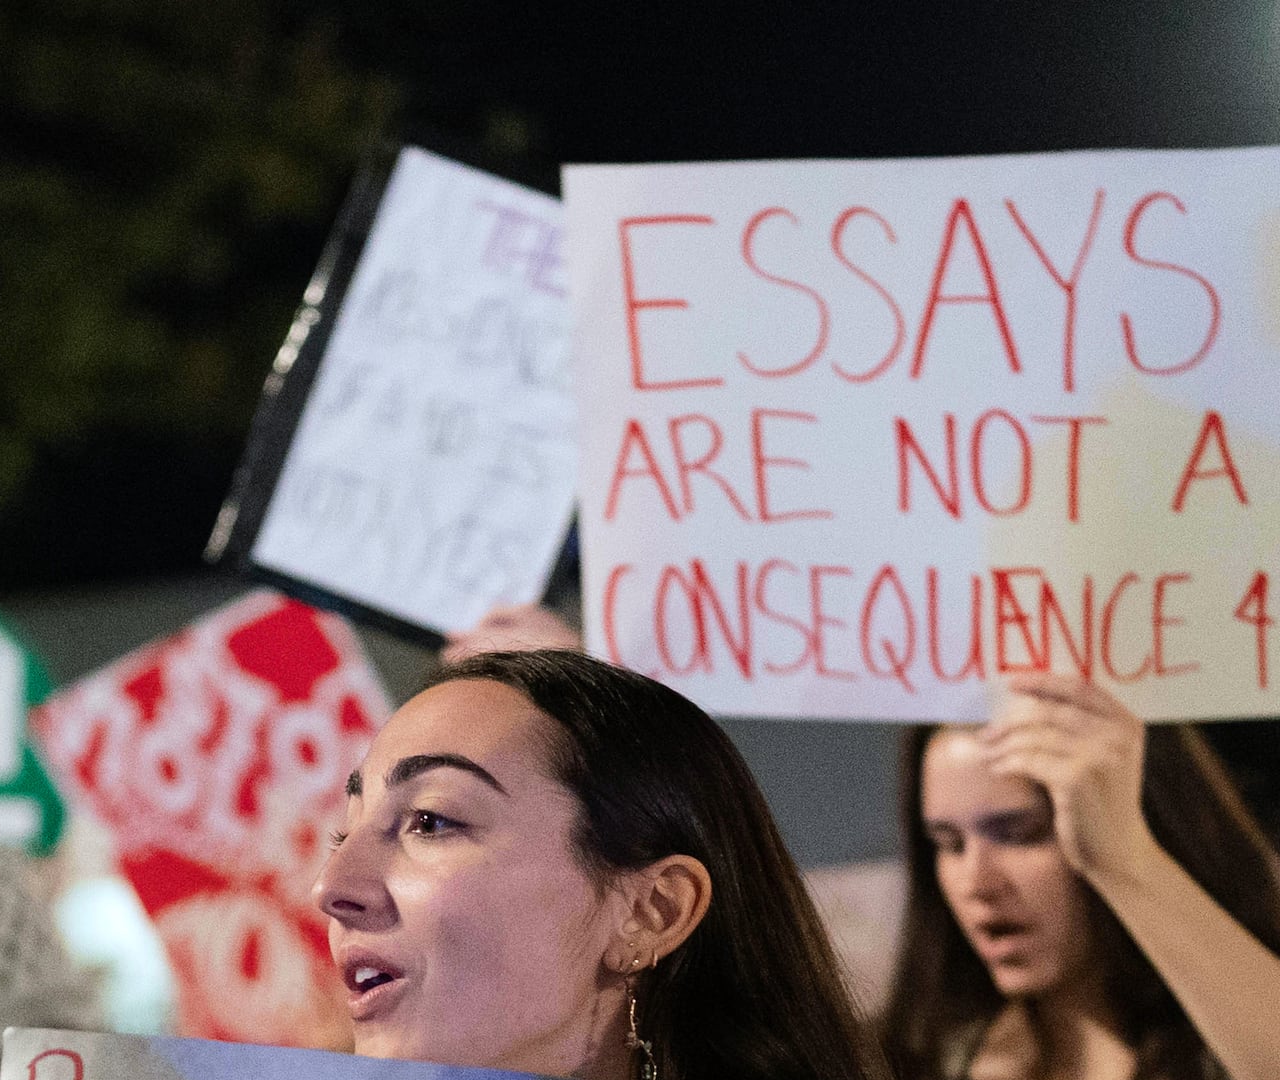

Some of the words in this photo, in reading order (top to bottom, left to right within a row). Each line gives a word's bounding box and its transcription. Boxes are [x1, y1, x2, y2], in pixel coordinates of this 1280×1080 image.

[618, 187, 1222, 393] ESSAYS
[603, 405, 834, 523] ARE
[895, 407, 1109, 524] NOT
[1171, 410, 1250, 513] A
[1233, 569, 1276, 690] 4
